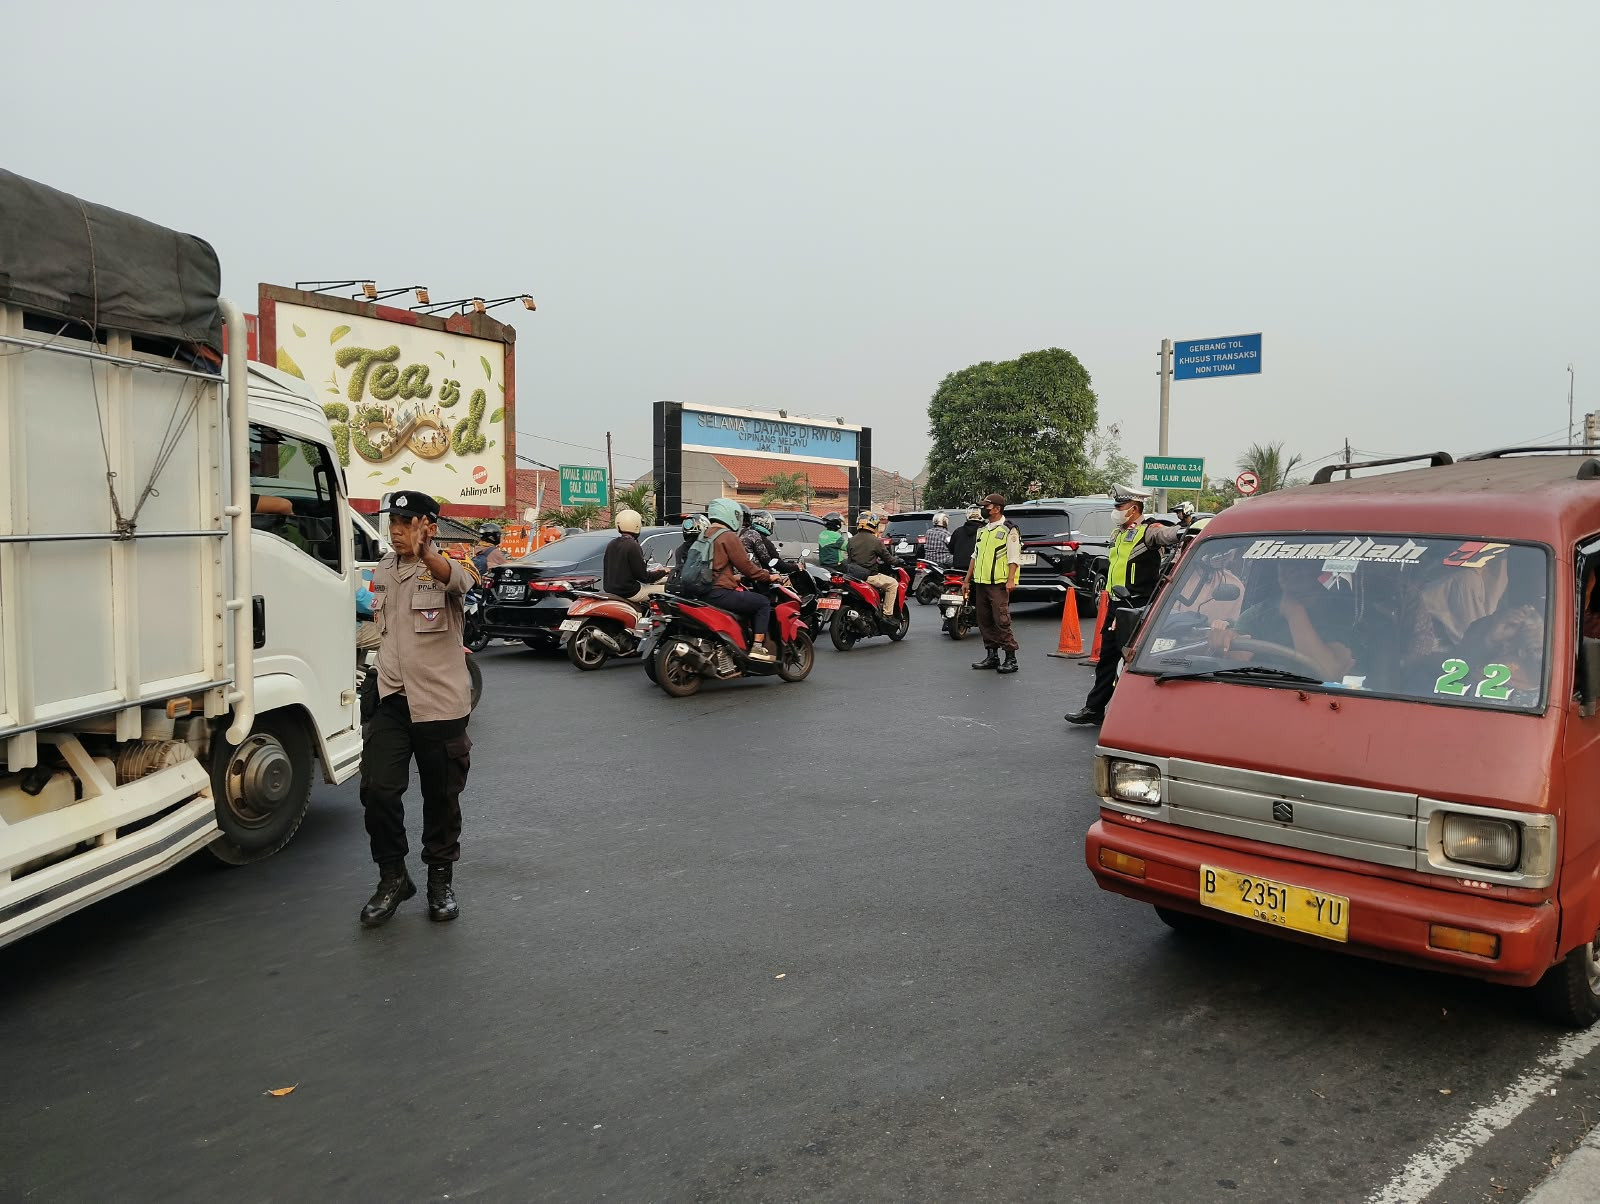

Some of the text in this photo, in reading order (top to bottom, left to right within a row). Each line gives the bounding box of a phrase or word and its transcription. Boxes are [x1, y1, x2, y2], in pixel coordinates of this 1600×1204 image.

[1189, 341, 1244, 353] GERBANG TOL
[1179, 350, 1257, 365] KHUSUS TRANSAKSI
[1195, 363, 1236, 374] NON TUNAI
[335, 345, 461, 408] Tea is
[697, 413, 842, 443] SELAMAT DATANG DI RW 09
[738, 432, 808, 448] CIPINANG MELAYU
[1145, 462, 1176, 470] KENDARAAN
[562, 468, 604, 482] ROYALE JAKARTA
[1181, 475, 1202, 483] KANAN
[460, 483, 501, 497] Ahlinya Teh
[569, 481, 598, 494] GOLF CLUB
[1242, 536, 1428, 559] Bismillah
[1205, 869, 1341, 925] B 2351 YU
